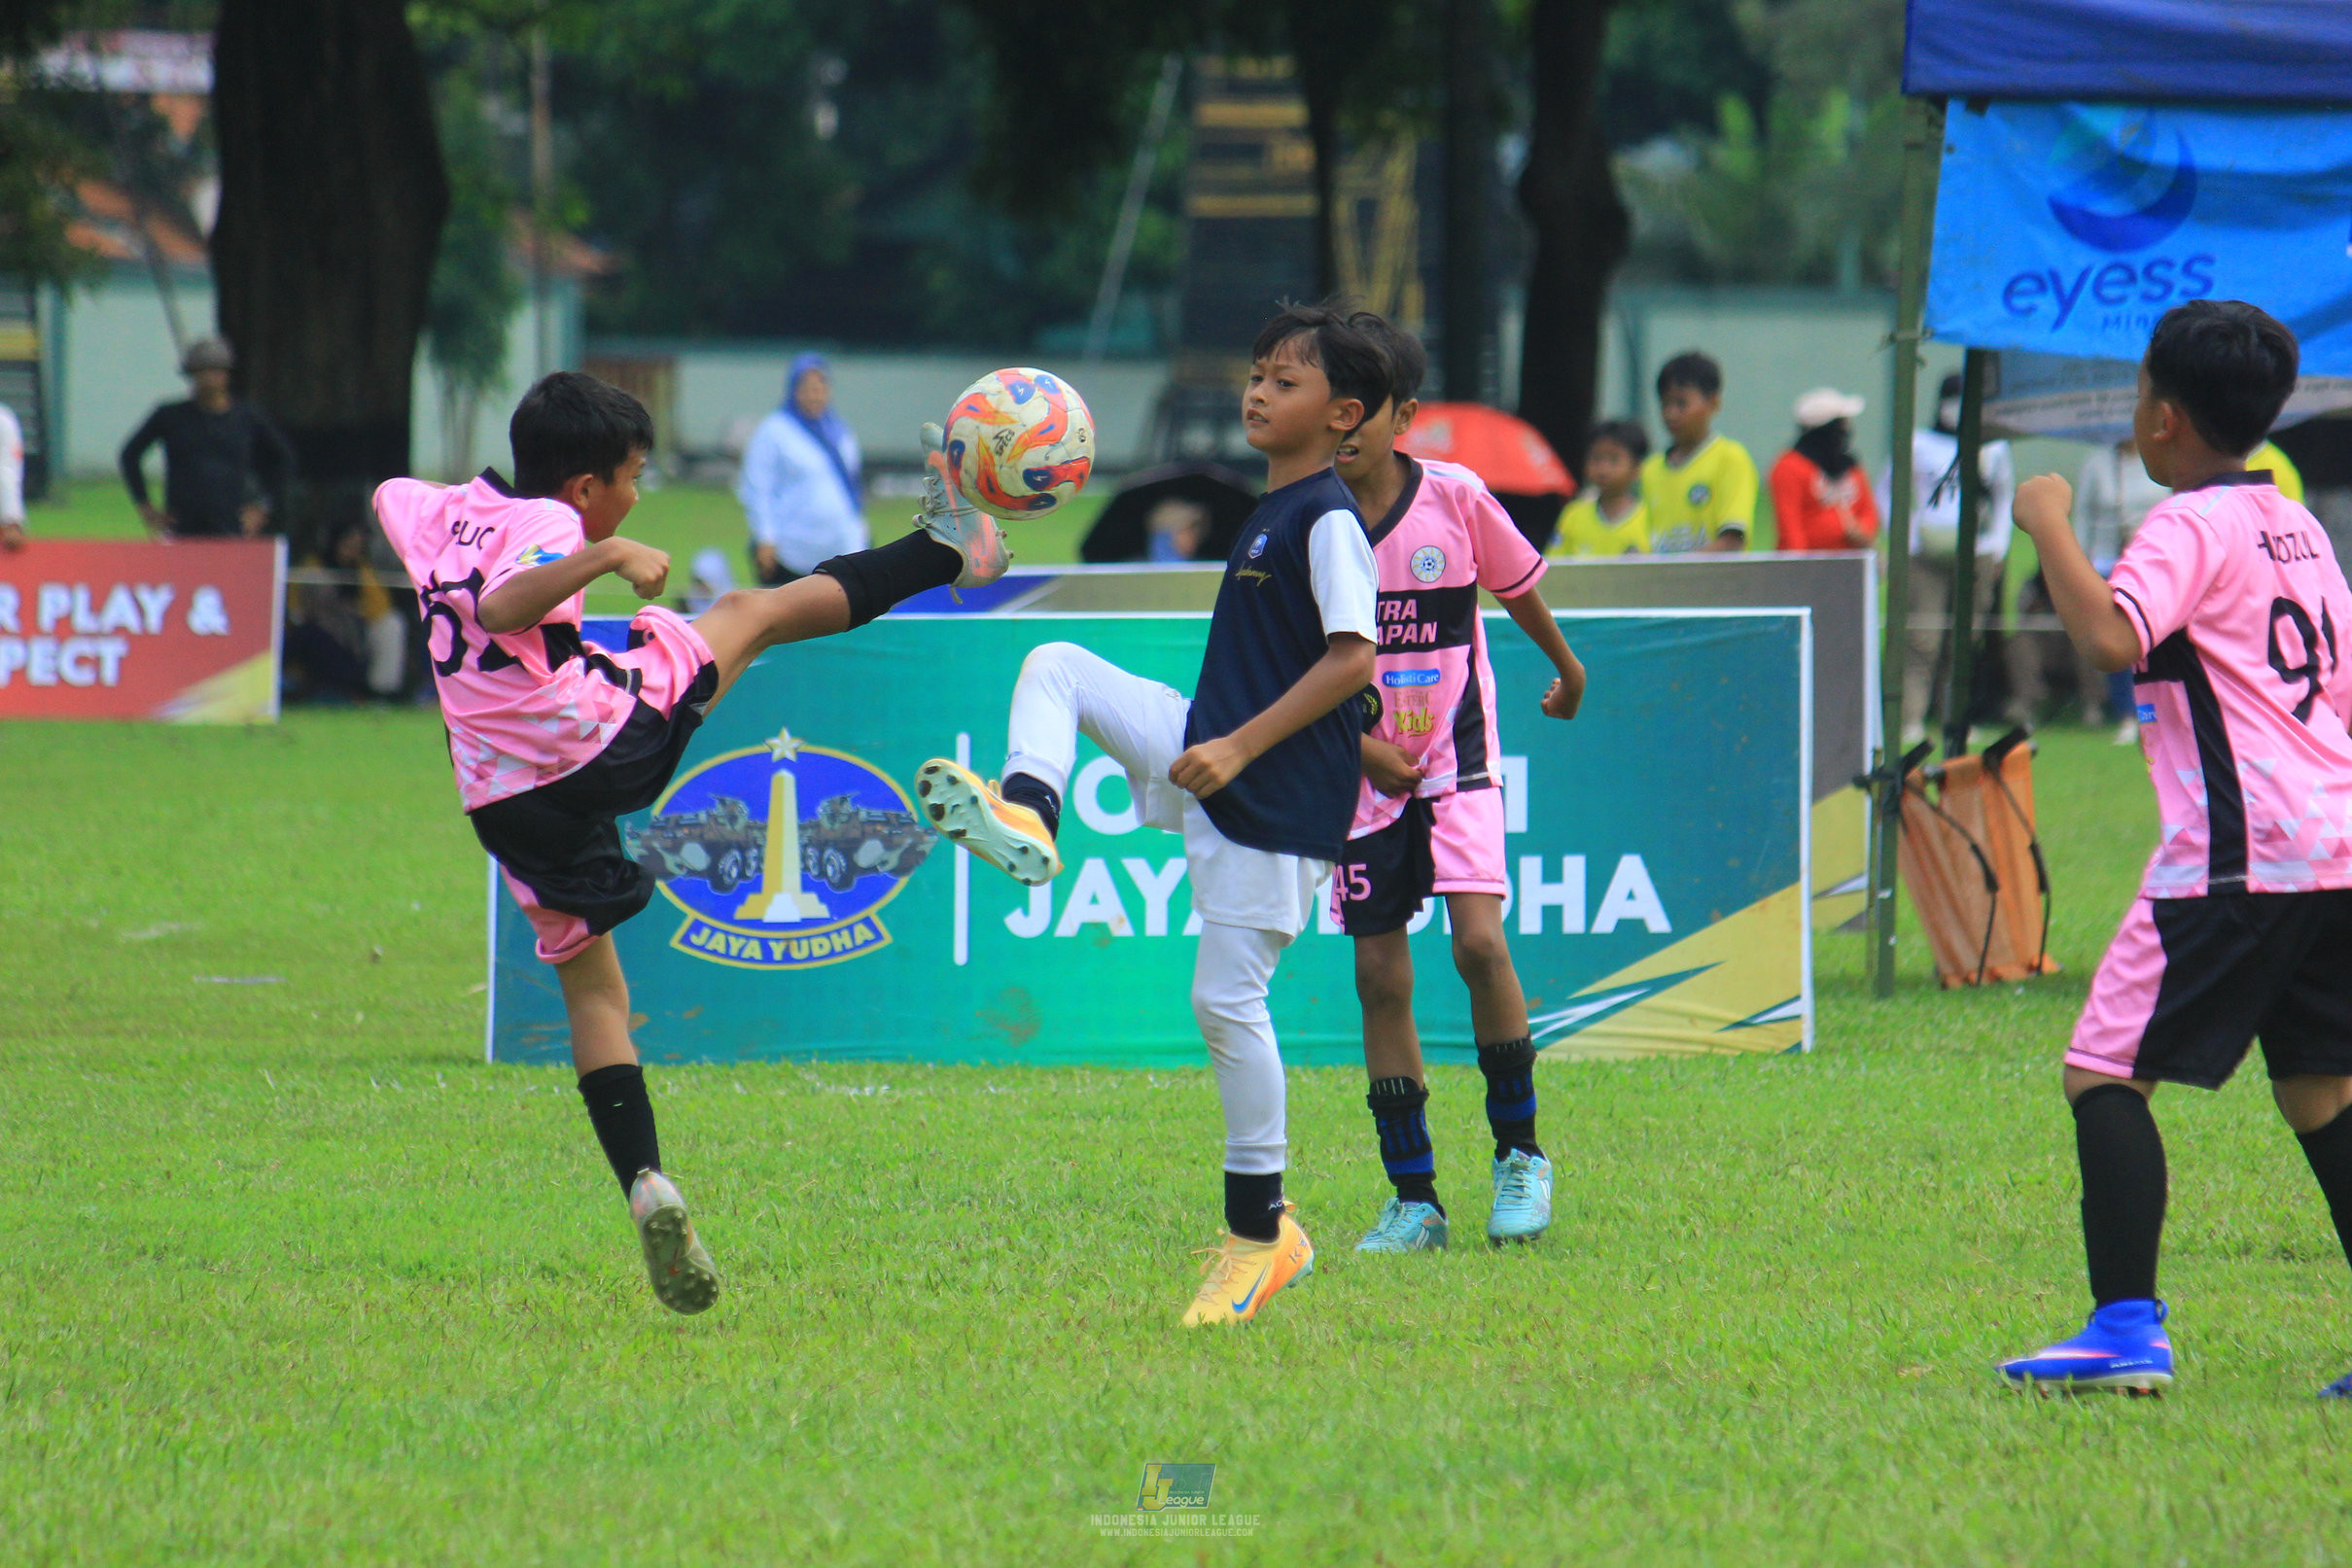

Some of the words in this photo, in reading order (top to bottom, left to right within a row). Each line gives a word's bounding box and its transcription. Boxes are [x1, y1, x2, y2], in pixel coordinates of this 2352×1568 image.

[2001, 251, 2217, 333] eyess
[37, 581, 176, 635] PLAY
[186, 584, 231, 637] &
[1377, 598, 1418, 622] TRA
[1377, 621, 1438, 646] APAN
[0, 634, 129, 688] PECT
[1392, 707, 1435, 735] Kids
[1003, 856, 1207, 939] JAY
[1333, 862, 1372, 902] 45
[689, 926, 763, 960] JAYA
[767, 923, 876, 961] YUDHA
